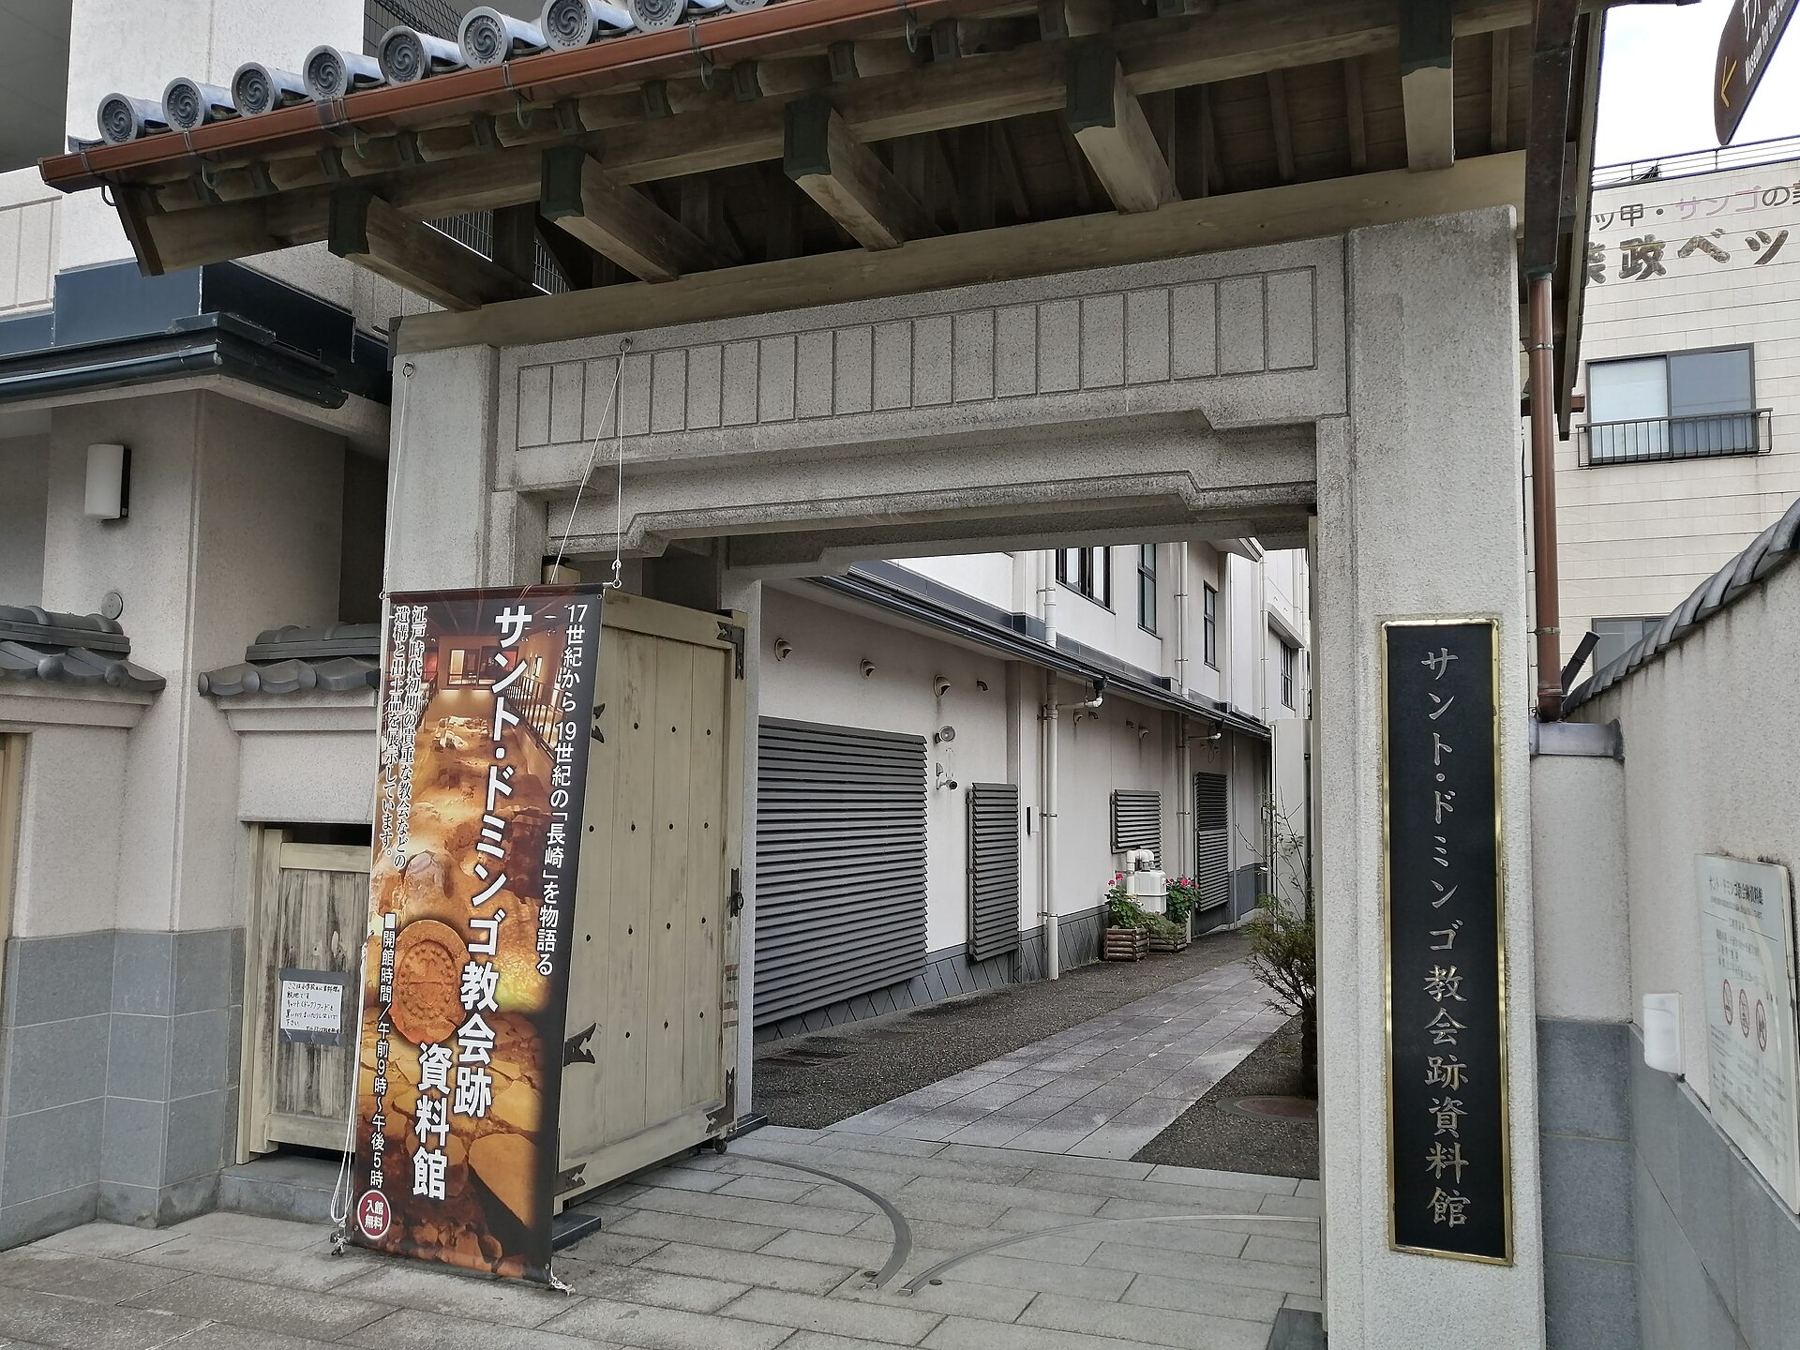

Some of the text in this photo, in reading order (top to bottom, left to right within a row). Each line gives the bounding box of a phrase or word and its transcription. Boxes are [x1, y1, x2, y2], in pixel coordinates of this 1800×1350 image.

[454, 605, 532, 1118] サント・ドミンゴ教会跡
[1421, 647, 1472, 1229] サント・ドミンゴ教会跡資料館
[413, 1043, 453, 1200] 資料館
[365, 1214, 383, 1231] 無料
[366, 1200, 384, 1215] 入館
